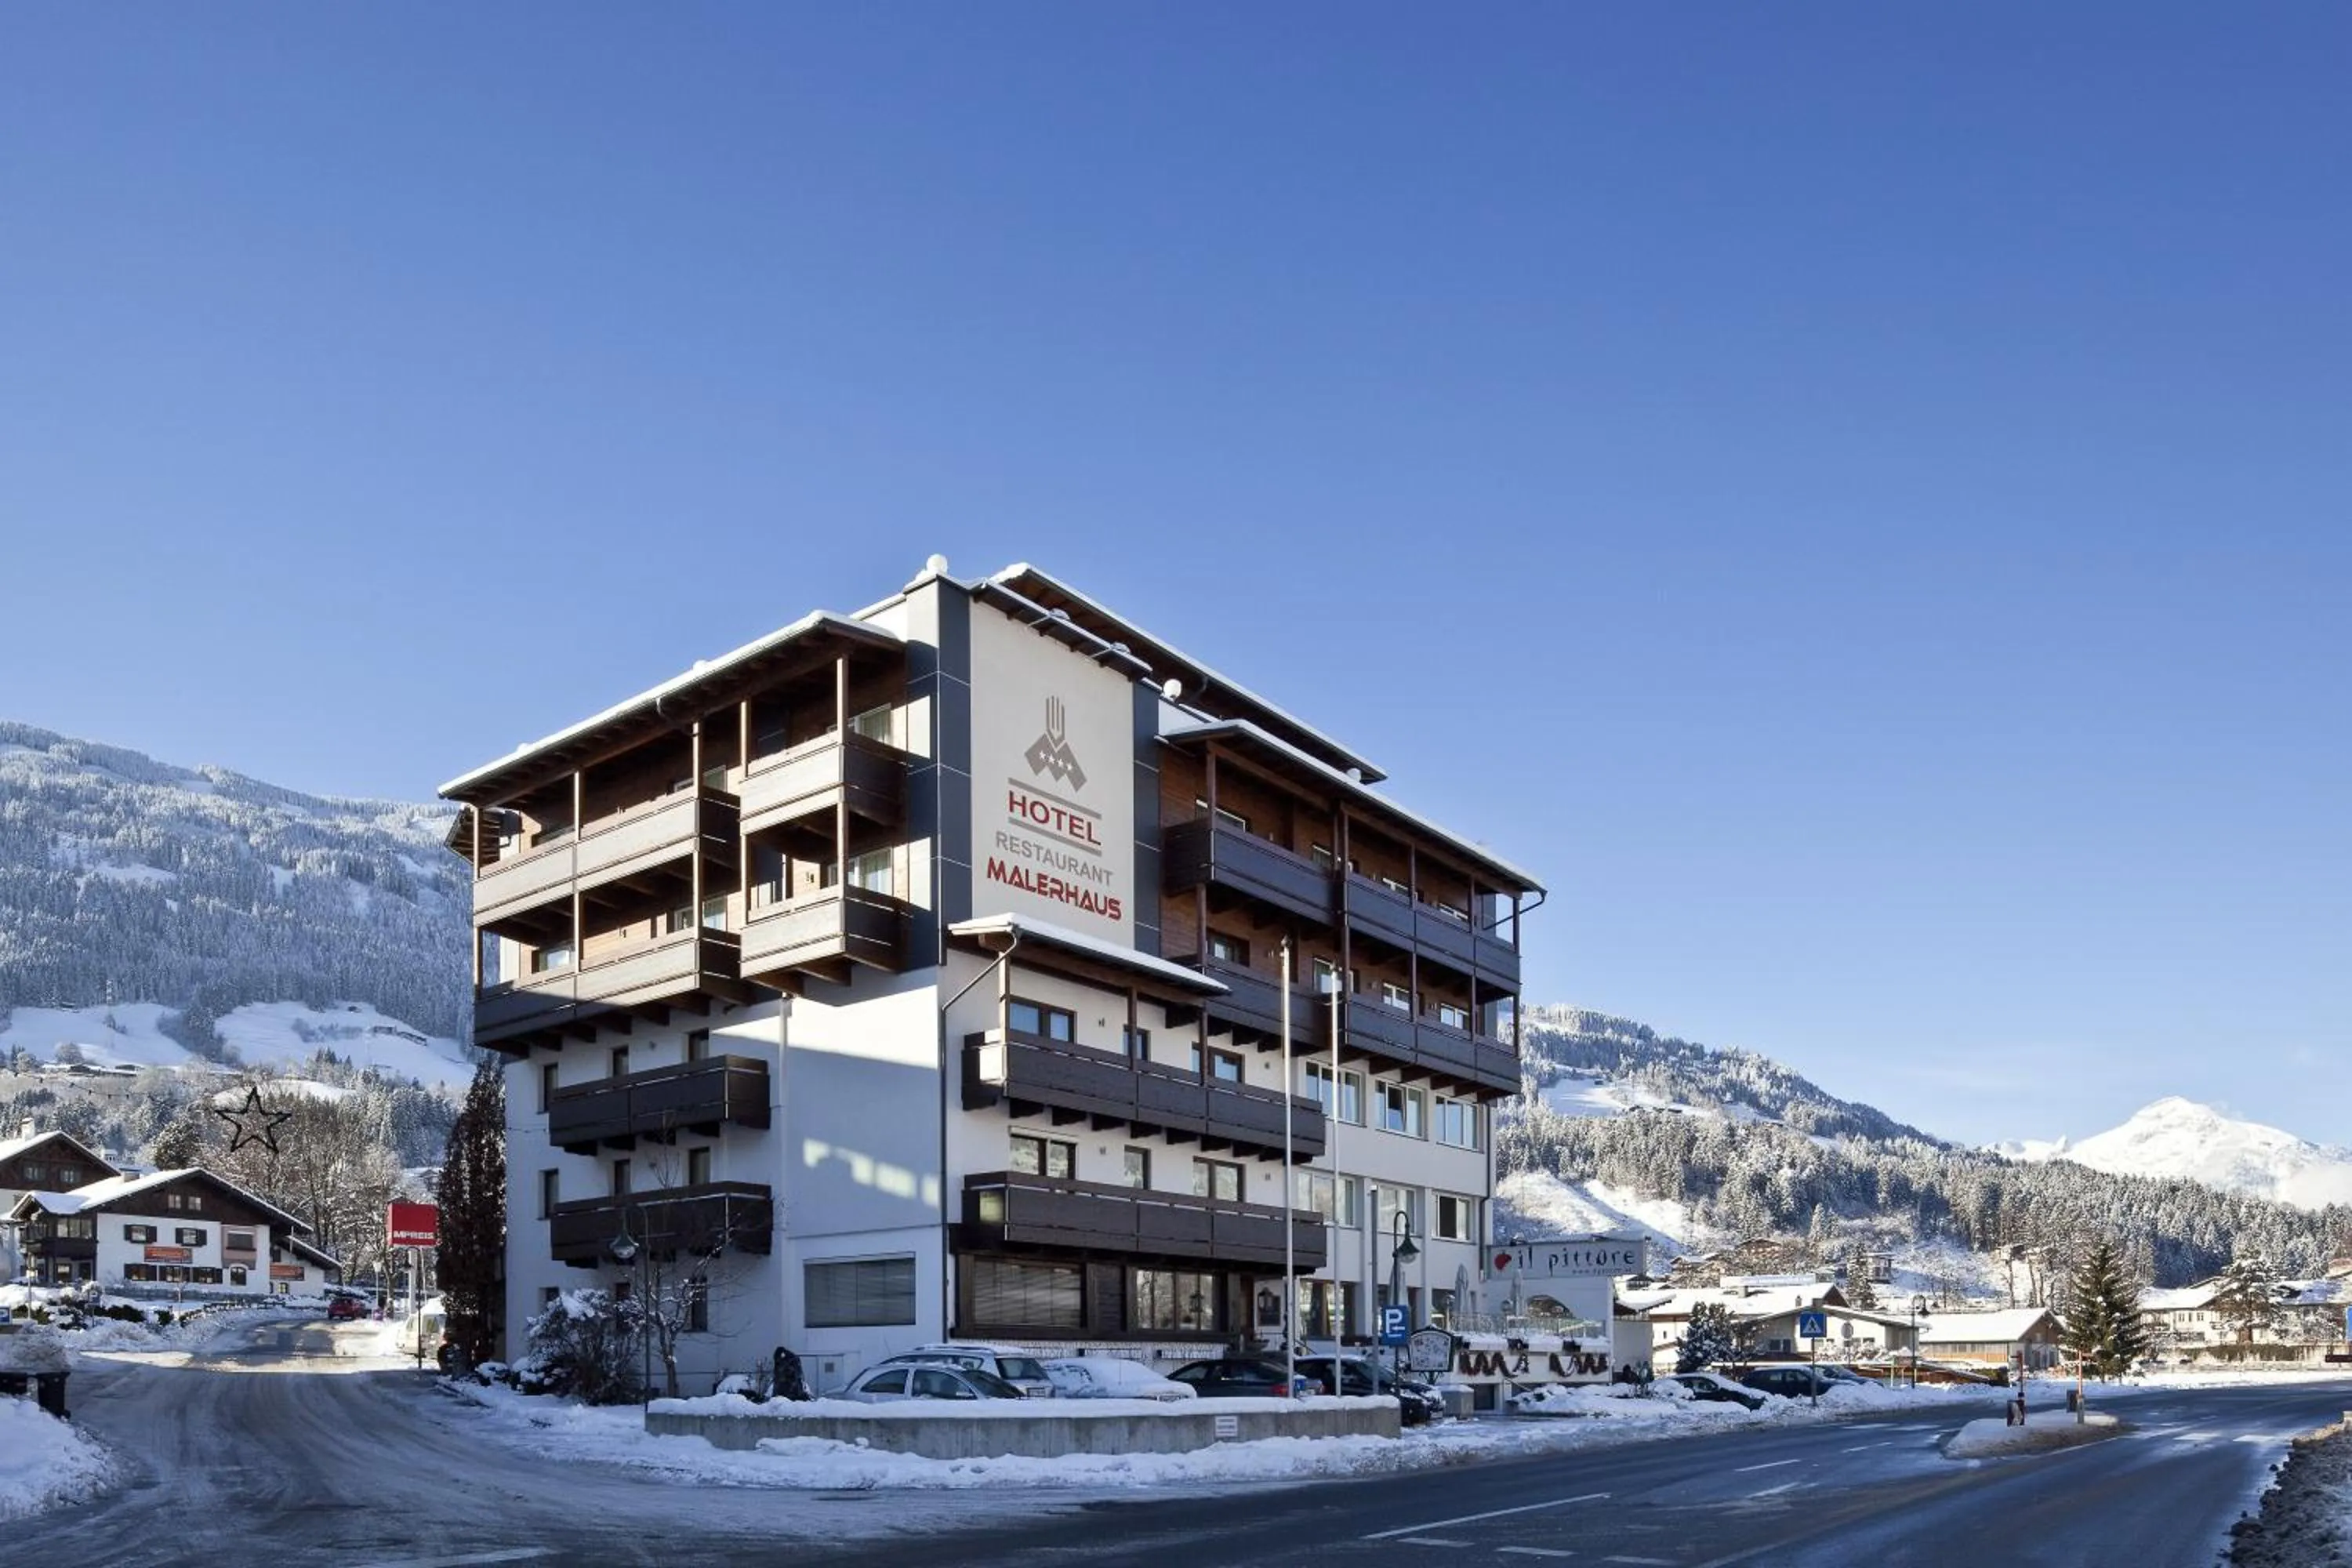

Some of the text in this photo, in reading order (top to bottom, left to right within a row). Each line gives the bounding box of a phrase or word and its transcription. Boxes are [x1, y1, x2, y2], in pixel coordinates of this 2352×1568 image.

[1008, 790, 1102, 846] HOTEL
[995, 831, 1113, 886] RESTAURANT
[986, 856, 1122, 920] MALERHAUS
[1549, 1247, 1635, 1276] pittore
[1385, 1308, 1403, 1334] P
